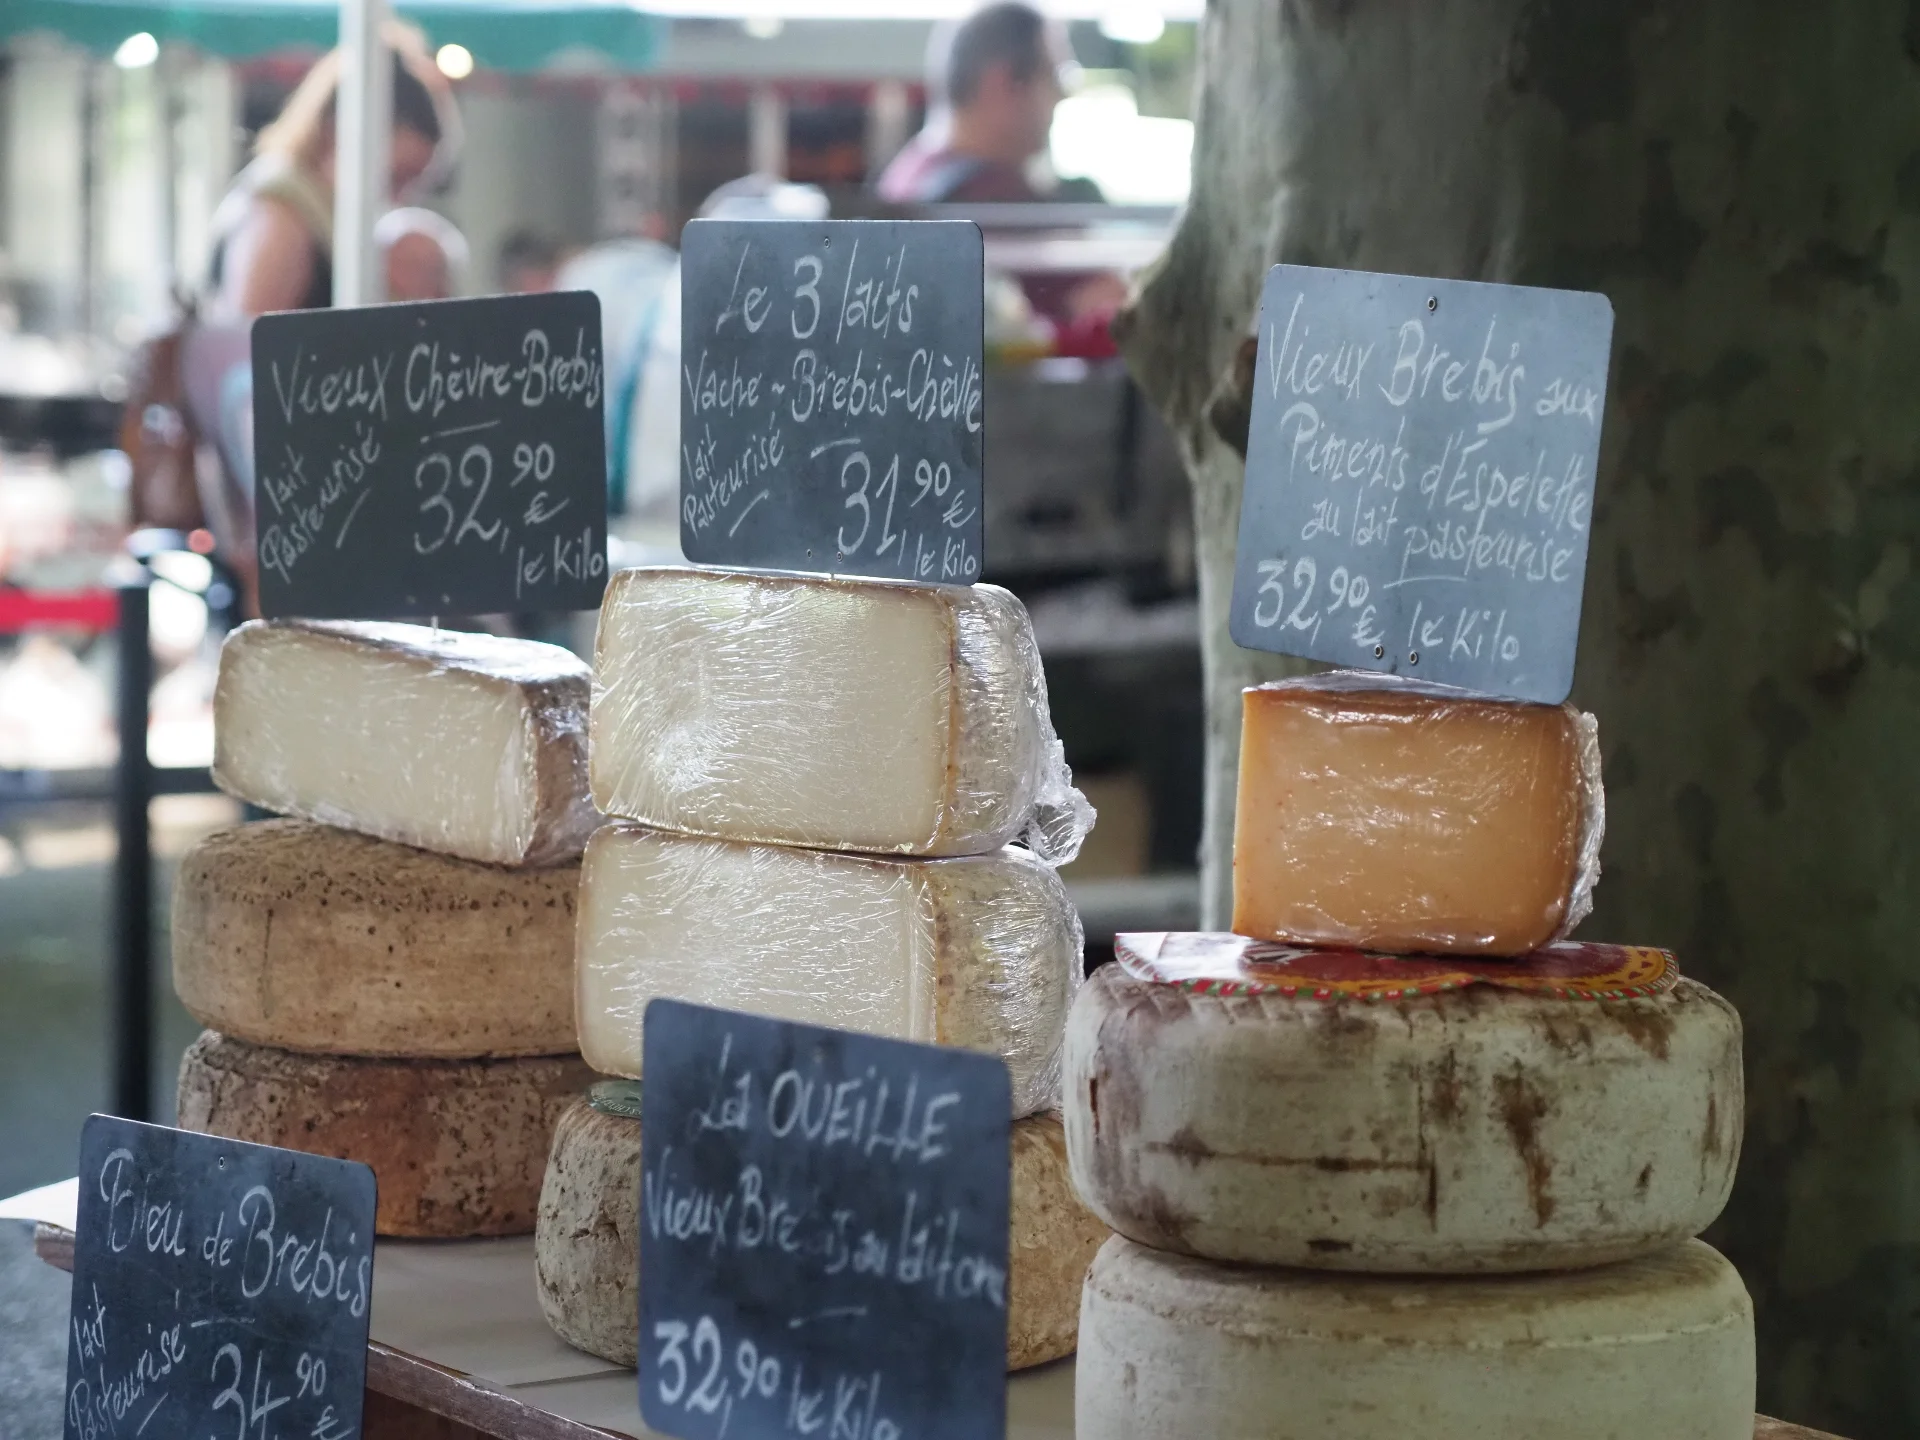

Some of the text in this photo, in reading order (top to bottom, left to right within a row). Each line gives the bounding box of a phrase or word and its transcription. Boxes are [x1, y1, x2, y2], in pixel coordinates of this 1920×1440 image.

[716, 238, 919, 344] Le 3 laits
[1269, 292, 1598, 434] Vieux Brebis aux
[264, 444, 308, 515] lait
[683, 423, 717, 487] lait
[1280, 401, 1409, 492] Piments
[914, 534, 976, 580] le Kilo
[1301, 499, 1341, 541] au
[1351, 486, 1399, 547] lait
[516, 527, 604, 599] le Kilo
[1408, 602, 1444, 648] le
[1450, 607, 1520, 662] Kilo
[700, 1032, 751, 1131] La
[100, 1148, 370, 1318] Bleu de Brebis
[645, 1145, 733, 1258] Vieux
[74, 1282, 106, 1374] lait
[786, 1363, 825, 1433] le
